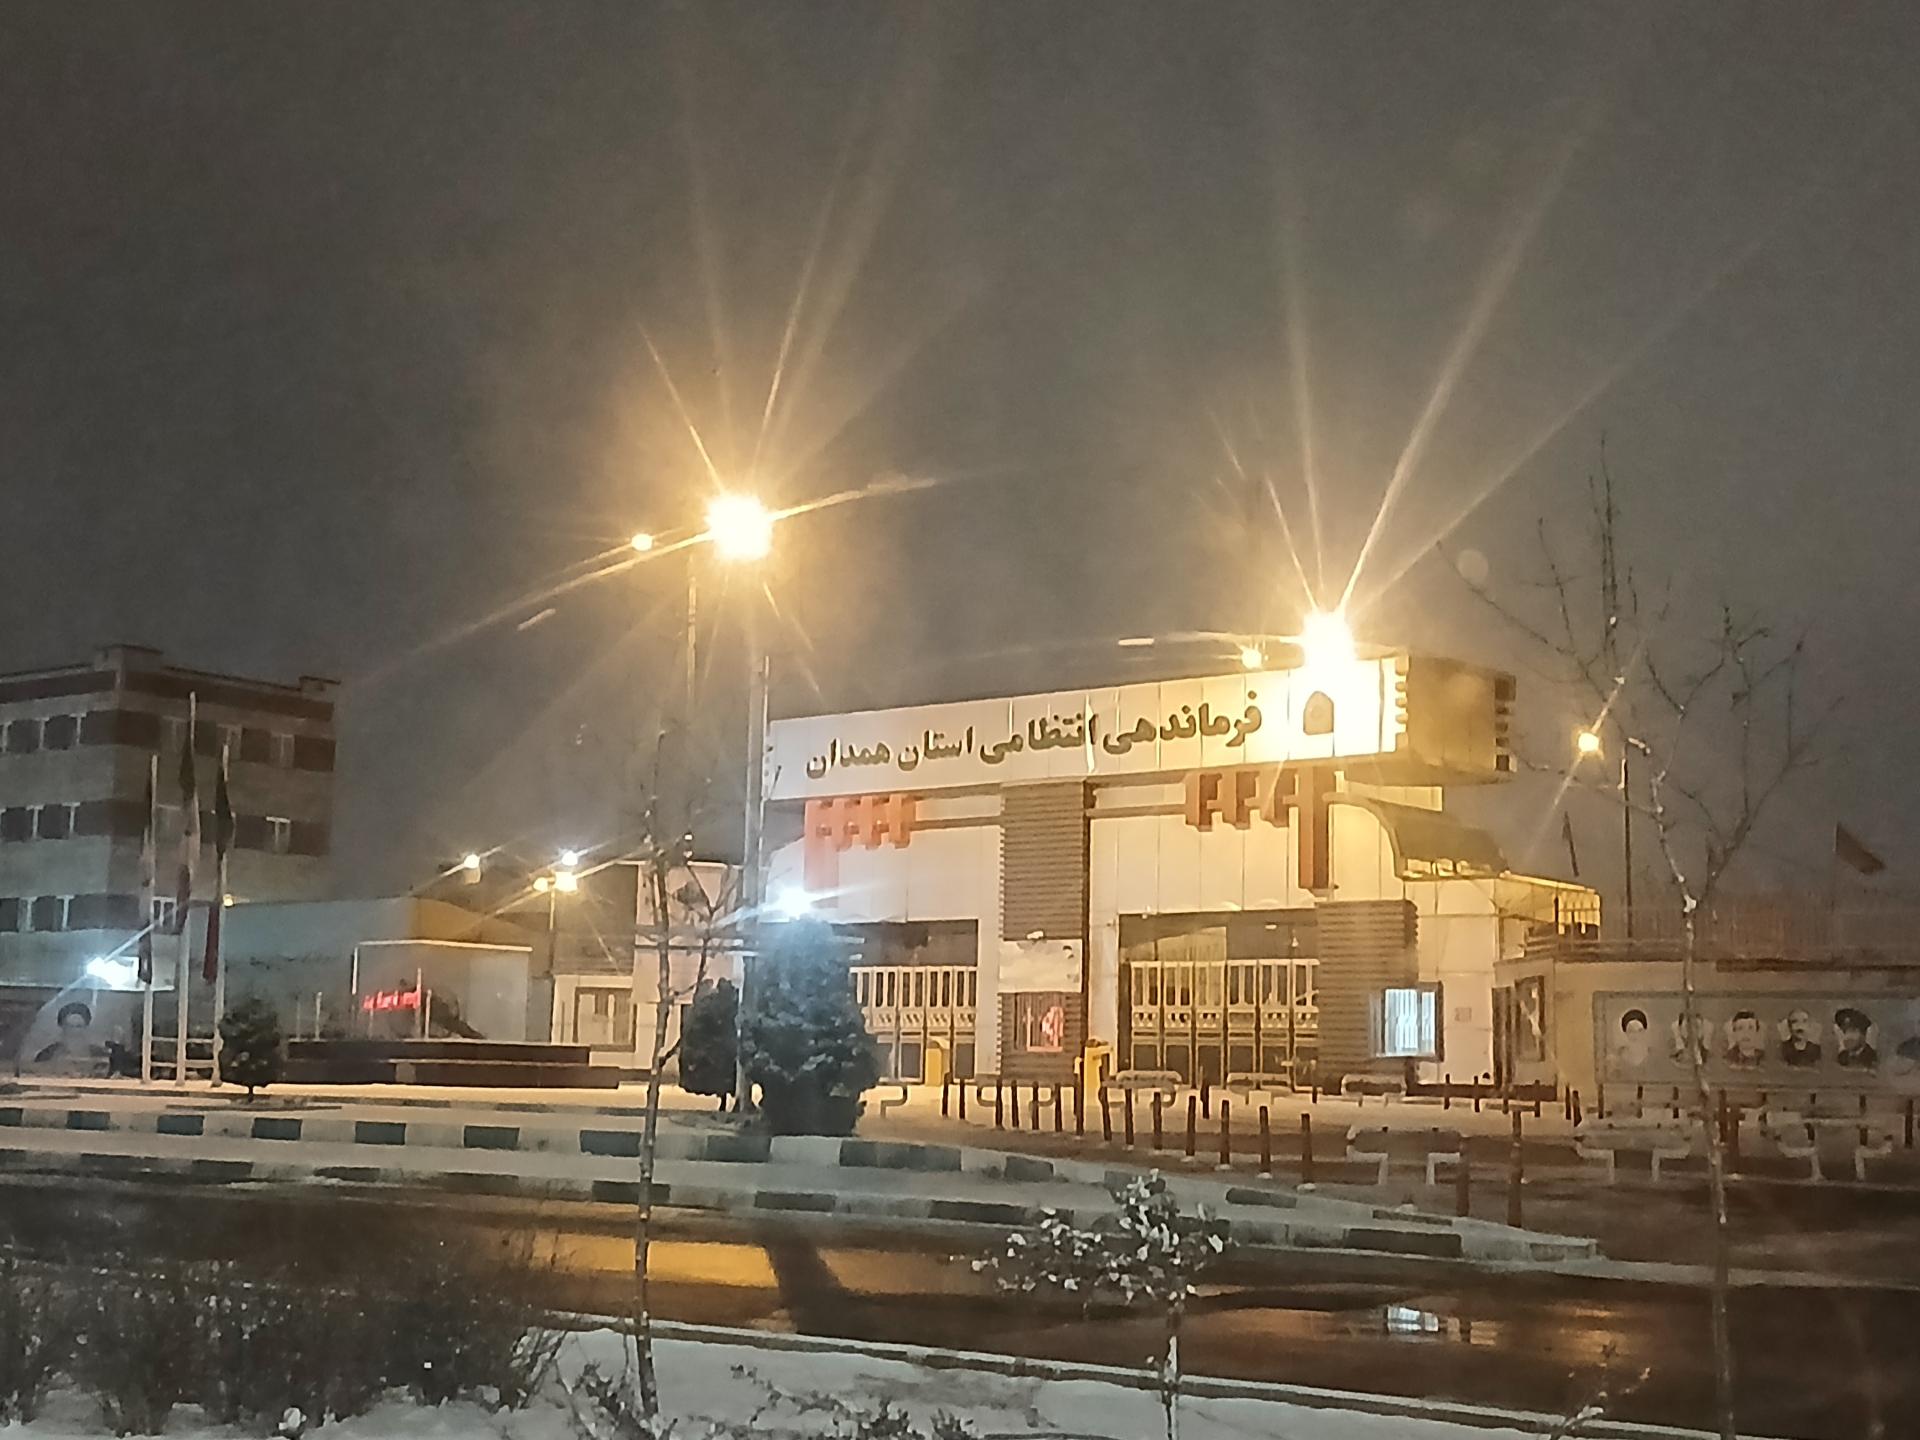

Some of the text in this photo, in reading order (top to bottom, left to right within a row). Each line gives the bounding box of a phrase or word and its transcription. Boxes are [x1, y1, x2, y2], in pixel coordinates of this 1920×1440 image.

[806, 690, 1263, 779] فرماندهی انتظامی استان همدان
